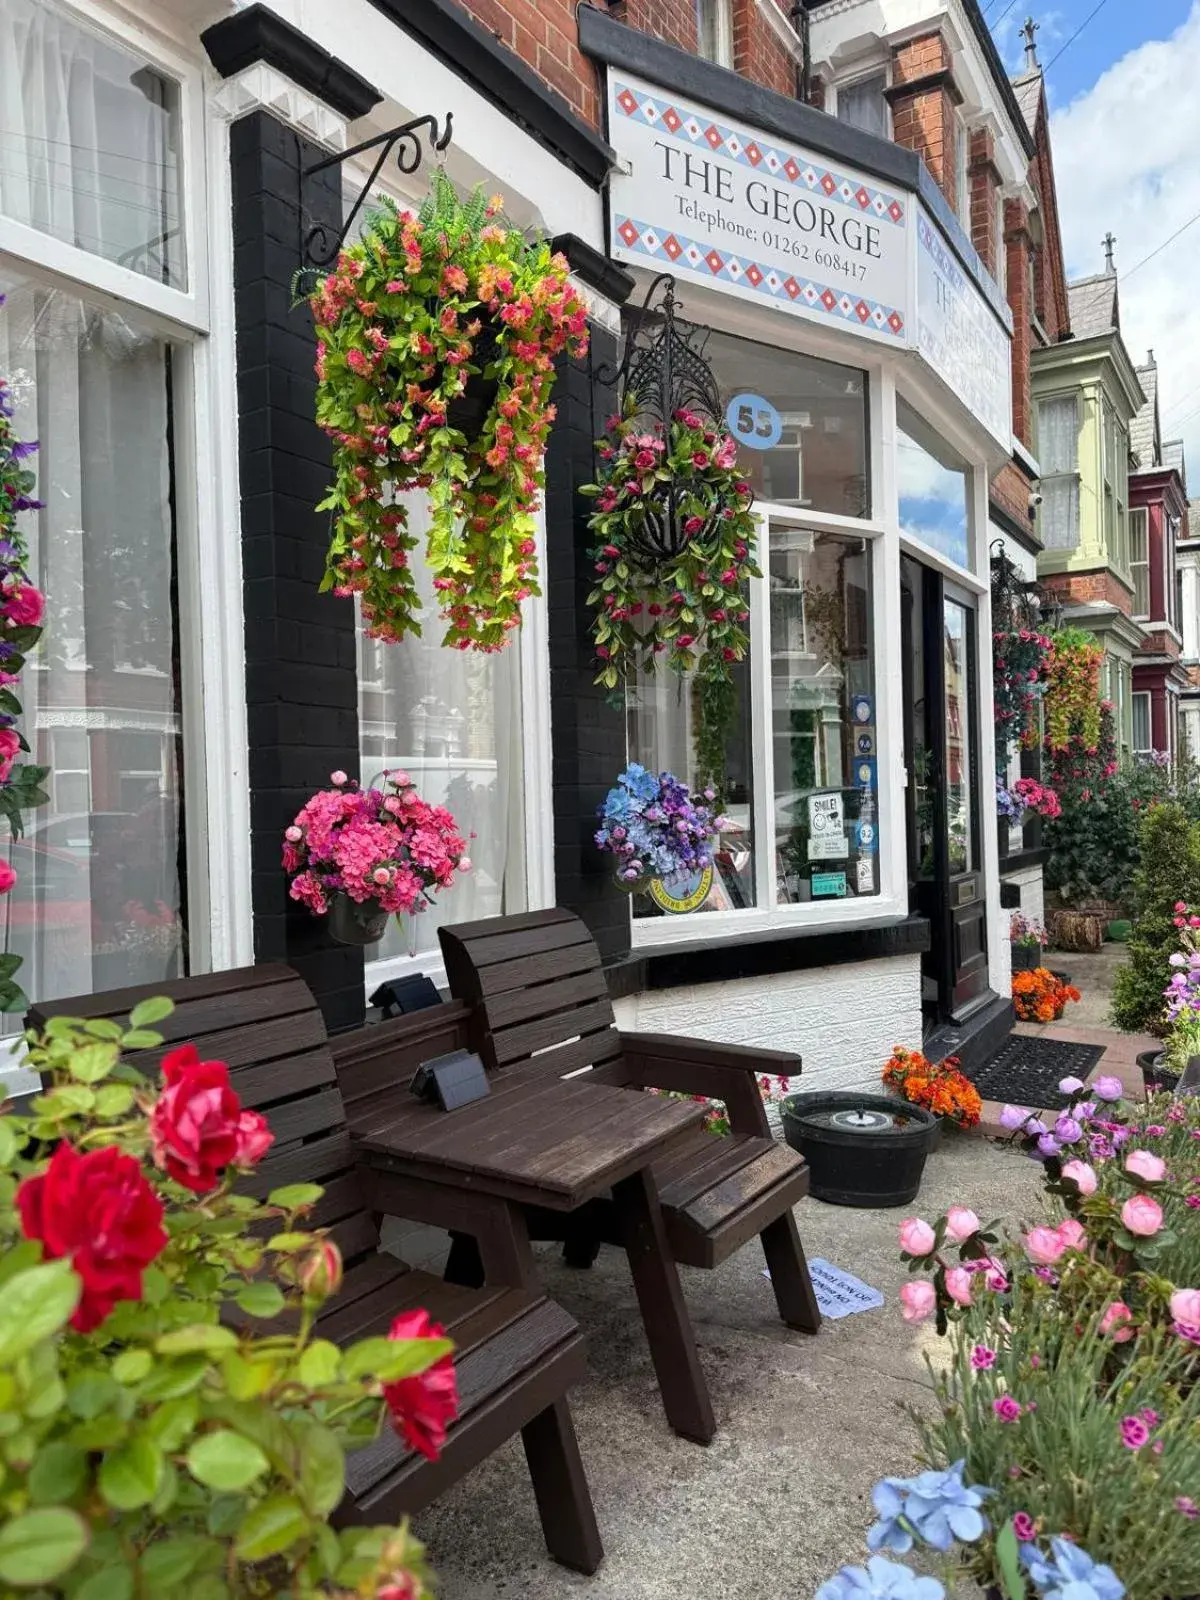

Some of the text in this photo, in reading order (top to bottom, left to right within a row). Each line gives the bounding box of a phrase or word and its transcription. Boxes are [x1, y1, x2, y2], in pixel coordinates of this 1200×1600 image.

[654, 141, 882, 259] THE GEORGE
[674, 194, 867, 282] Telephone: 01262 608417
[737, 405, 773, 438] 55
